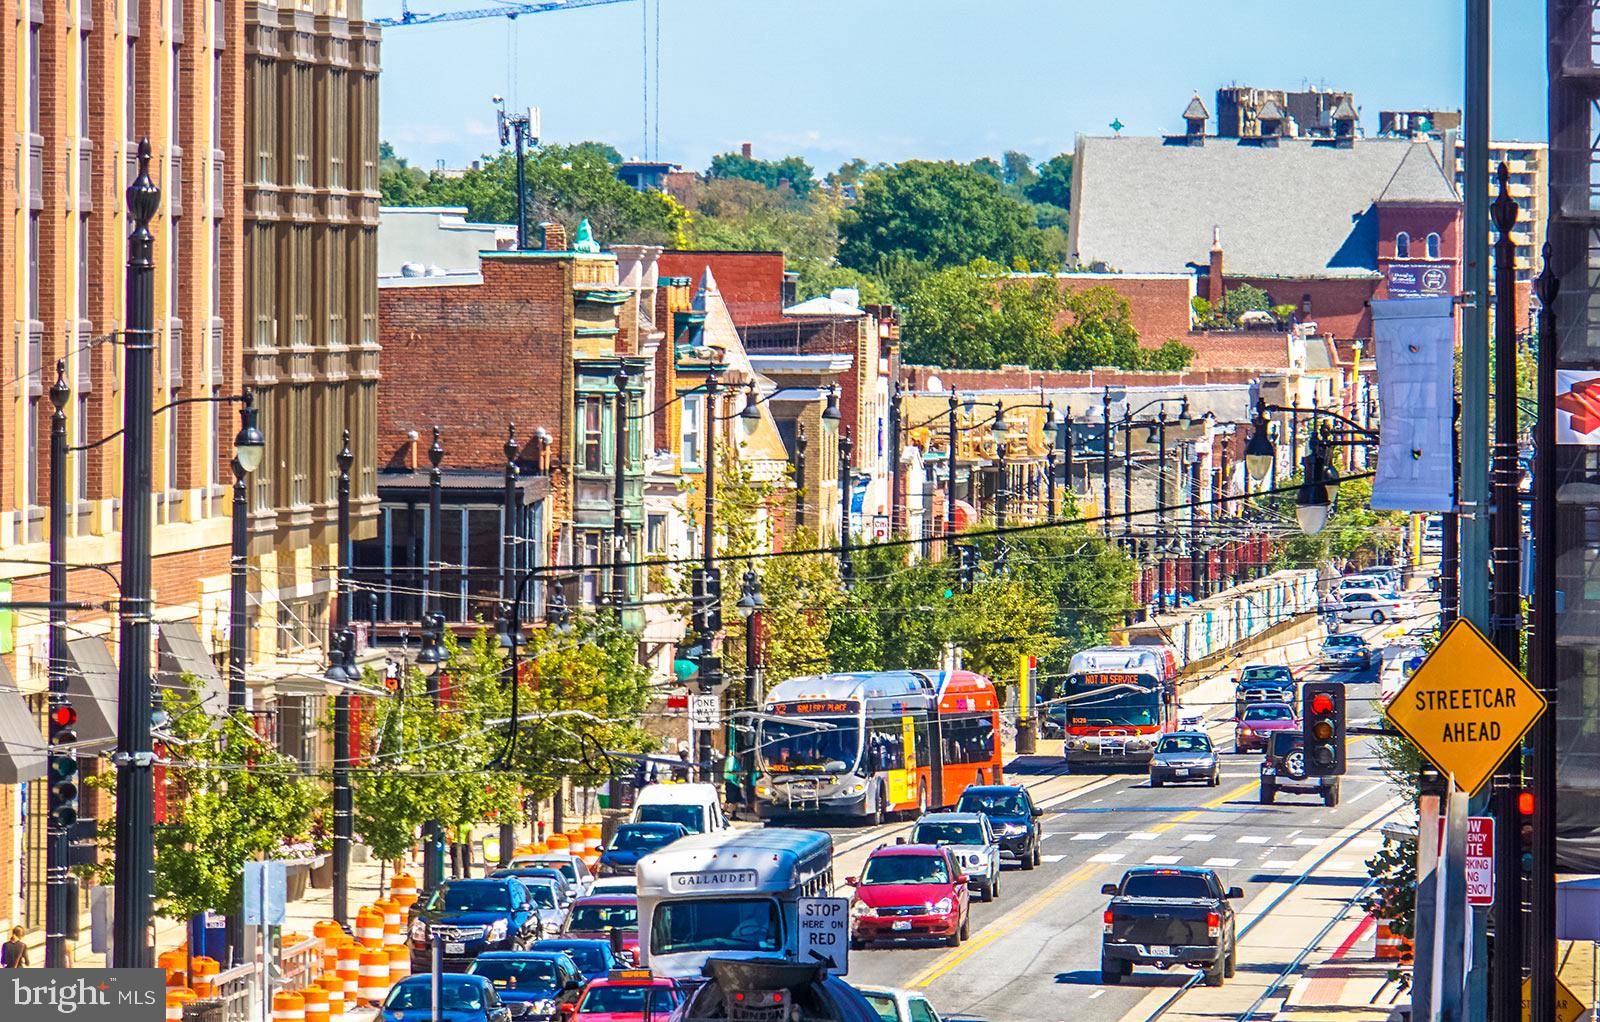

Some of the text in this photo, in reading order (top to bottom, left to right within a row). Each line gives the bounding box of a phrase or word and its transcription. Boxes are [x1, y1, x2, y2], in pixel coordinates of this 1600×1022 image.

[1085, 675, 1139, 684] NOT IN SERVICE
[697, 699, 715, 707] ONE
[1415, 687, 1517, 711] STREETCAR
[696, 708, 716, 716] WAY
[1442, 721, 1502, 743] AHEAD
[677, 873, 755, 886] GALLAUDET
[805, 903, 841, 917] STOP
[802, 920, 844, 929] HERE ON
[809, 932, 836, 945] RED
